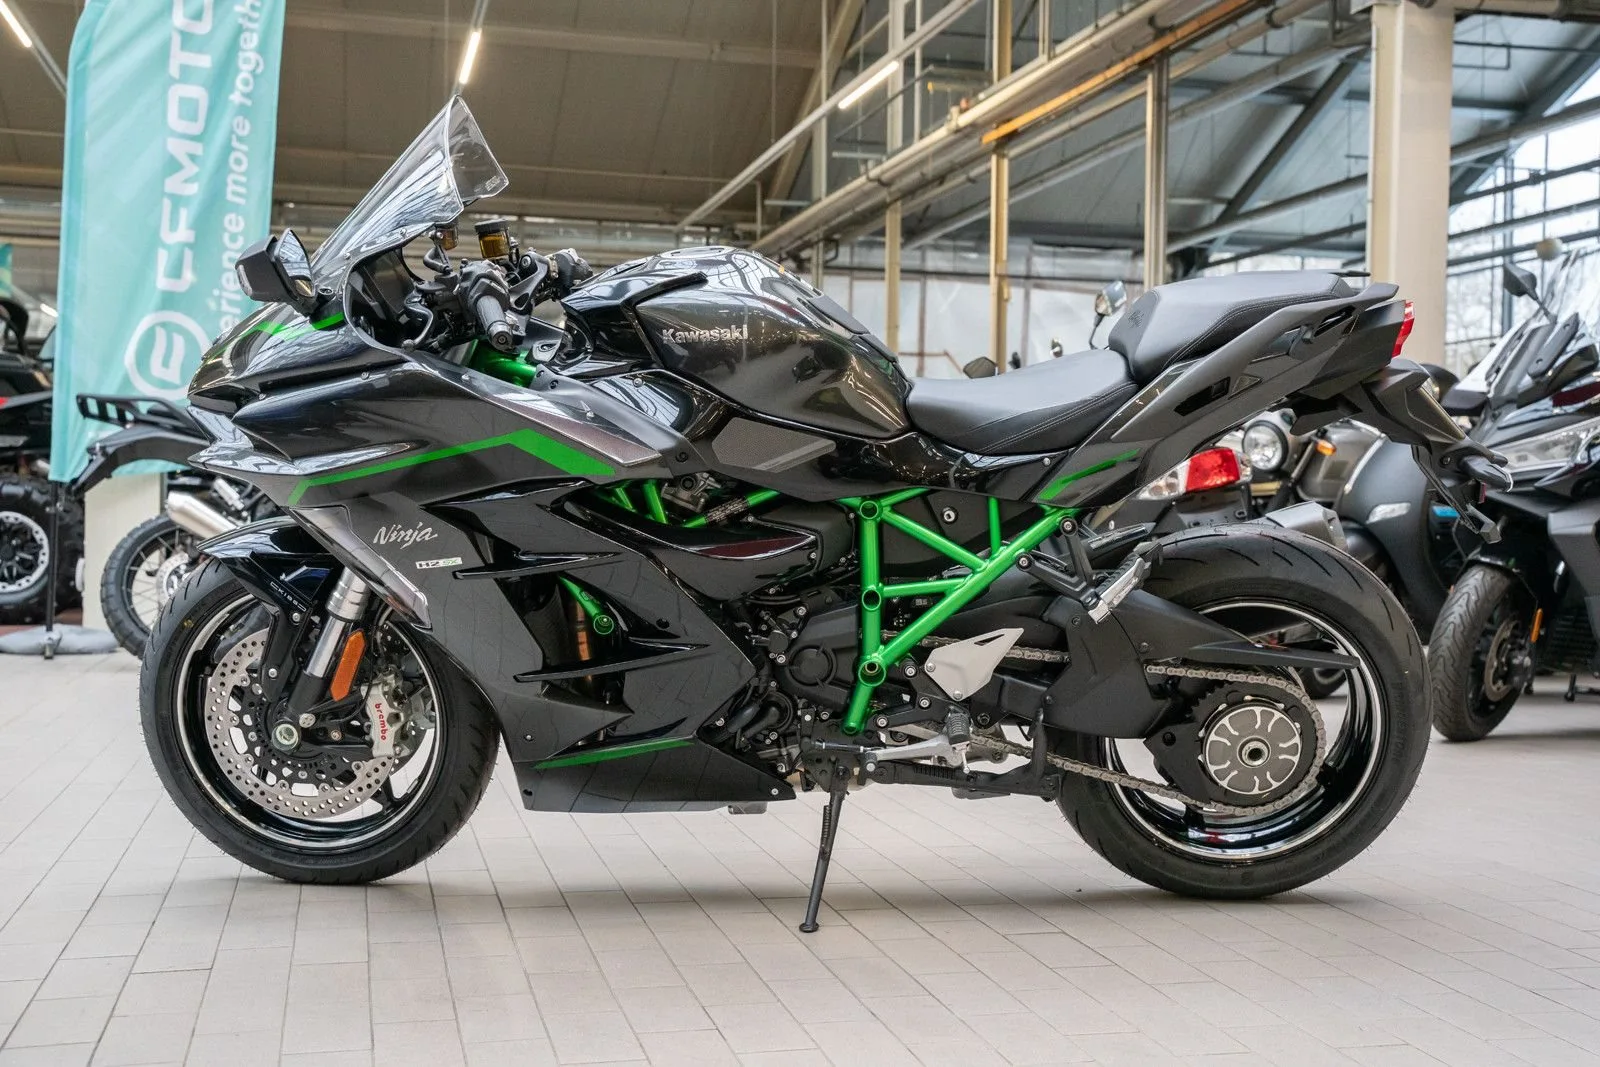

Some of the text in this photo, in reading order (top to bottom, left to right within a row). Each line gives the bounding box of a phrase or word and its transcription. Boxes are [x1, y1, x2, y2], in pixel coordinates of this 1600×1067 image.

[226, 115, 251, 205] more
[662, 324, 749, 344] Kawasaki
[373, 522, 438, 549] Ninja
[374, 702, 388, 741] brembo
